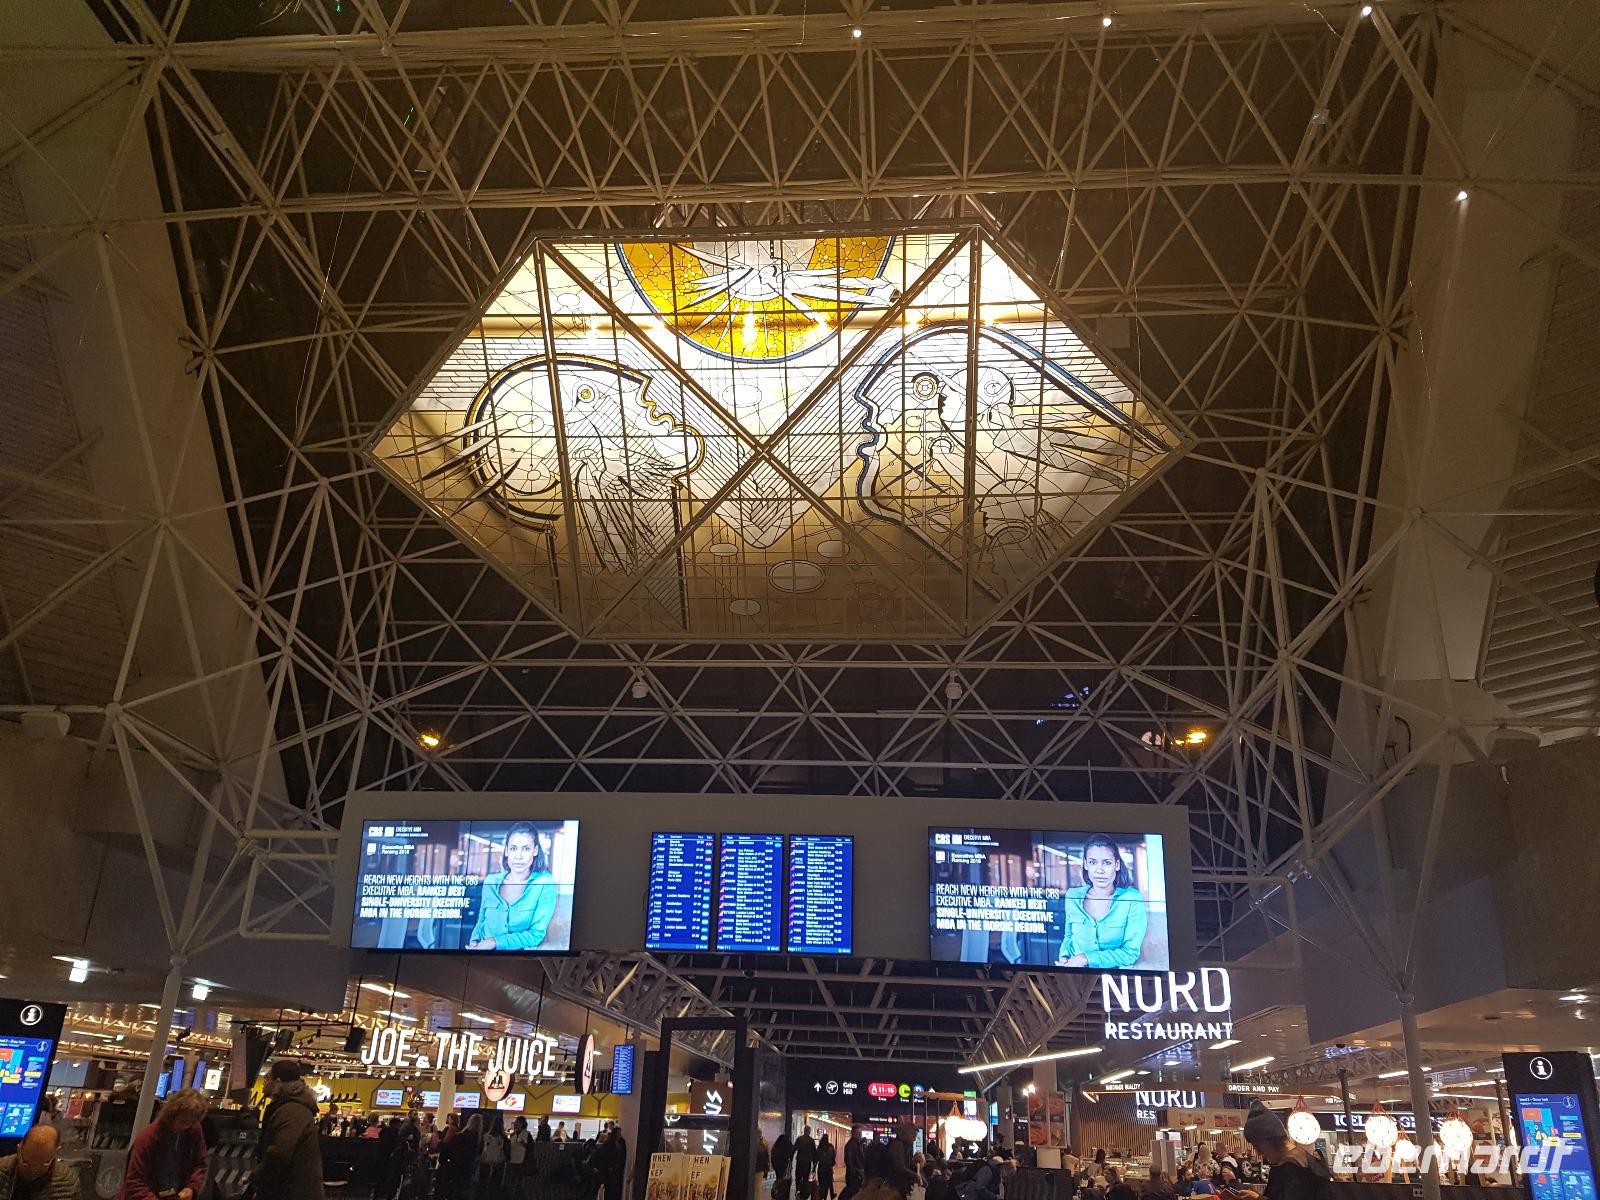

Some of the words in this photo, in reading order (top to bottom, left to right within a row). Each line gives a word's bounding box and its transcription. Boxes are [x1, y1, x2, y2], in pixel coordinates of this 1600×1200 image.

[935, 833, 951, 845] CBS
[363, 874, 386, 885] REACH
[386, 874, 403, 885] NEW
[404, 875, 431, 885] HEIGHTS
[432, 875, 450, 886] WITH
[451, 876, 465, 886] THE
[465, 876, 479, 886] CBS
[362, 885, 397, 896] EXECUTIVE
[397, 886, 416, 896] MBA.
[447, 887, 467, 897] BEST
[936, 883, 959, 895] REACH
[960, 884, 978, 896] NEW
[979, 885, 1008, 897] HEIGHTS
[1009, 886, 1028, 898] WITH
[1028, 887, 1043, 899] THE
[1045, 888, 1060, 900] CBS
[361, 896, 432, 907] SINGLE-UNIVERSITY
[432, 897, 470, 908] EXECUTIVE
[936, 895, 972, 907] EXECUTIVE
[973, 896, 993, 908] MBA.
[994, 897, 1026, 909] RANKED
[1027, 899, 1048, 910] BEST
[360, 907, 378, 918] MBA
[379, 908, 389, 918] IN
[389, 908, 403, 918] THE
[936, 907, 1011, 920] SINGLE-UNIVERSITY
[1012, 910, 1054, 922] EXECUTIVE
[936, 918, 956, 930] MBA
[956, 919, 967, 930] IN
[967, 919, 982, 931] THE
[983, 920, 1014, 932] NORDIC
[1104, 1022, 1233, 1040] RESTAURANT
[360, 1027, 414, 1067] JOE
[416, 1055, 430, 1069] &
[436, 1031, 483, 1073] THE
[487, 1036, 559, 1077] JUICE
[871, 1086, 878, 1095] A
[1228, 1084, 1250, 1093] ORDER
[1252, 1085, 1266, 1093] AND
